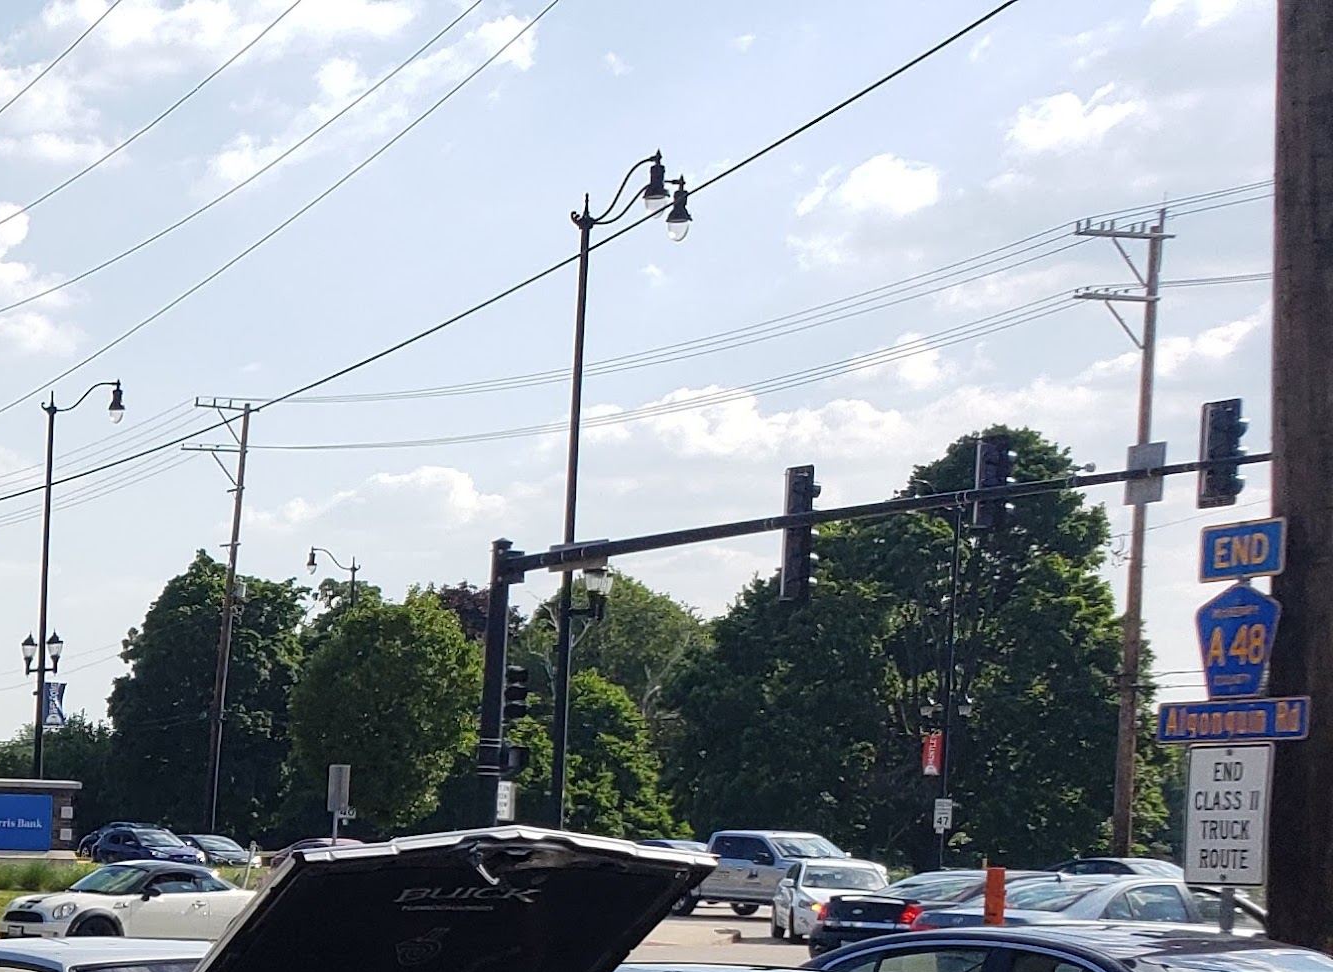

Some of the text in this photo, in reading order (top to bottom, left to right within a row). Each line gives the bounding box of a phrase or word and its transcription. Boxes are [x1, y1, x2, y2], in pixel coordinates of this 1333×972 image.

[1213, 532, 1270, 569] END
[1229, 624, 1266, 665] 48
[1165, 701, 1300, 738] Algonquin Rd
[1212, 761, 1244, 782] END
[1194, 790, 1242, 811] CLASS
[17, 818, 43, 828] Bank
[936, 816, 949, 826] 47
[1200, 820, 1251, 840] TRUCK
[1199, 849, 1250, 869] ROUTE
[393, 887, 541, 903] BUICK
